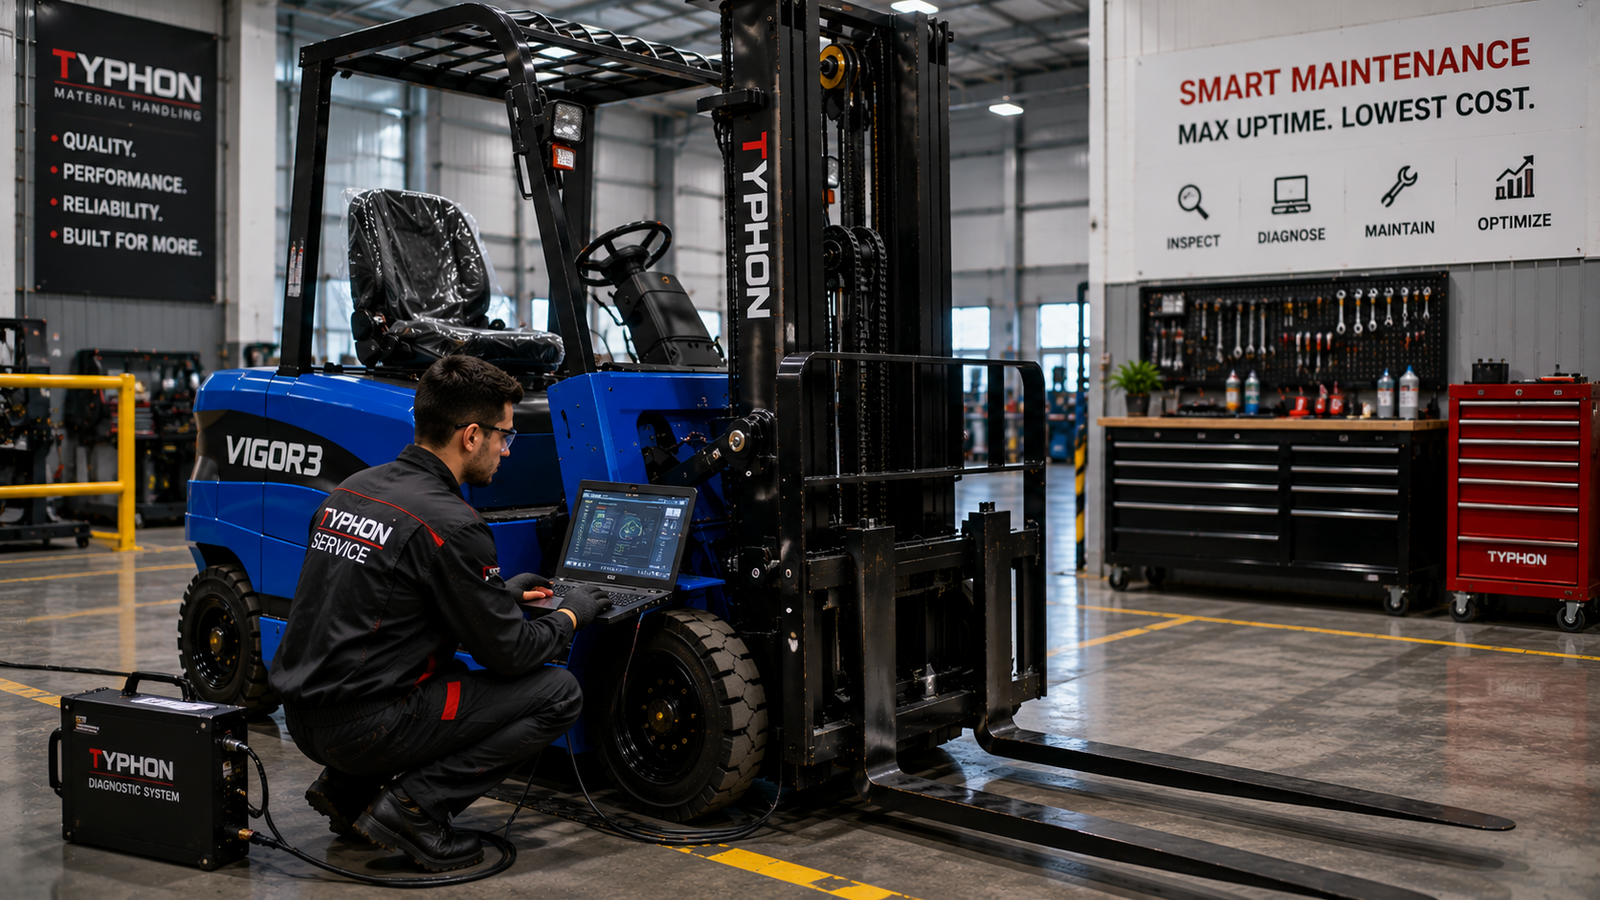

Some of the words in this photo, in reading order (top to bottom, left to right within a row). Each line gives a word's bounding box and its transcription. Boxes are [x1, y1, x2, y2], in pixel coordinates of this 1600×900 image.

[52, 48, 202, 103] TYPHON
[1179, 68, 1281, 106] SMART
[1291, 36, 1531, 93] MAINTENANCE
[54, 87, 125, 110] MATERIAL
[132, 100, 202, 122] HANDLING
[1178, 118, 1230, 145] MAX
[1236, 108, 1333, 139] UPTIME.
[1341, 94, 1448, 129] LOWEST
[1455, 86, 1536, 117] COST.
[63, 131, 137, 157] QUALITY.
[63, 163, 187, 194] PERFORMANCE.
[63, 195, 163, 222] RELIABILITY.
[1477, 212, 1552, 231] OPTIMIZE
[742, 131, 771, 319] TYPHON
[1257, 227, 1326, 244] DIAGNOSE
[1364, 220, 1436, 238] MAINTAIN
[63, 227, 112, 248] BUILT
[115, 232, 149, 252] FOR
[152, 236, 203, 257] MORE.
[1166, 234, 1221, 250] INSPECT
[226, 435, 323, 477] VIGOR3
[320, 507, 394, 546] TYPHON
[311, 532, 371, 565] SERVICE
[1487, 550, 1547, 566] TYPHON
[88, 748, 174, 781] TYPHON
[88, 777, 141, 796] DIAGNOSTIC
[143, 788, 180, 803] SYSTEM
